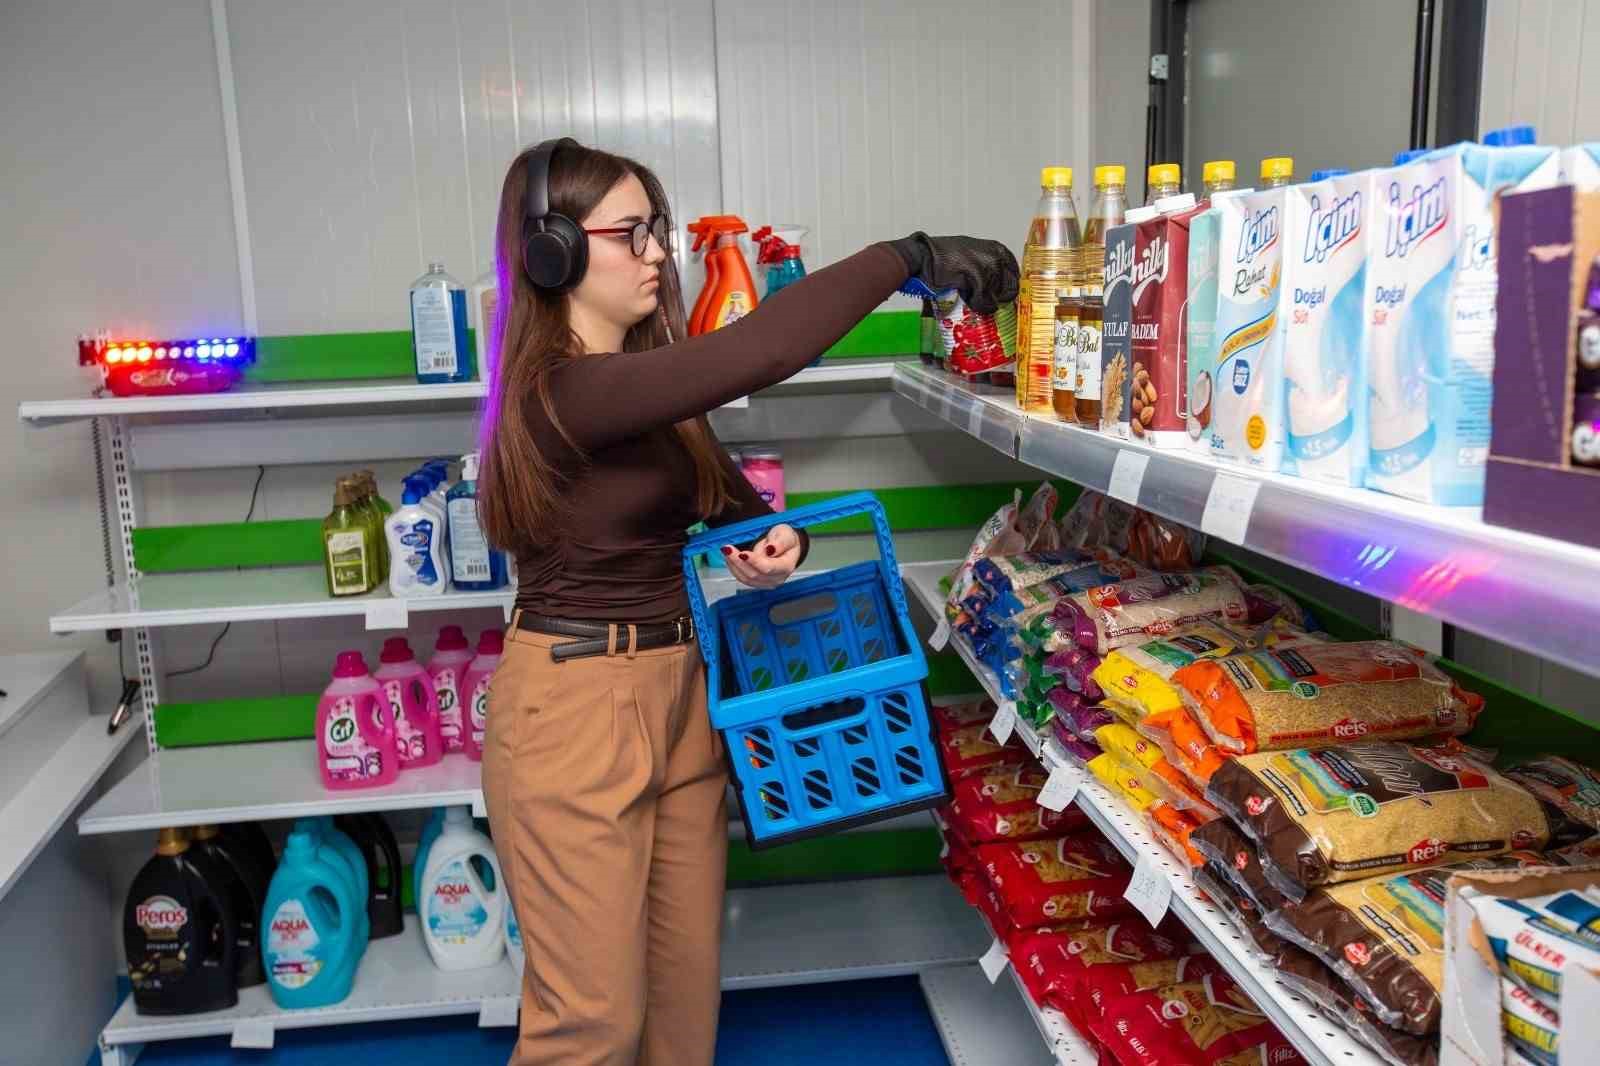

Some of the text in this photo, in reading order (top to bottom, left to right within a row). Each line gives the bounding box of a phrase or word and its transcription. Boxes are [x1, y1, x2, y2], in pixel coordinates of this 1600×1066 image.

[1294, 285, 1326, 309] Doğal
[1375, 283, 1407, 308] Doğal
[1103, 321, 1129, 337] YULAF
[1131, 323, 1160, 340] BADEM
[332, 722, 353, 741] Cif
[1334, 719, 1368, 737] Reis
[434, 883, 471, 896] AQUA
[137, 904, 187, 926] Peros
[271, 919, 309, 931] AQUA
